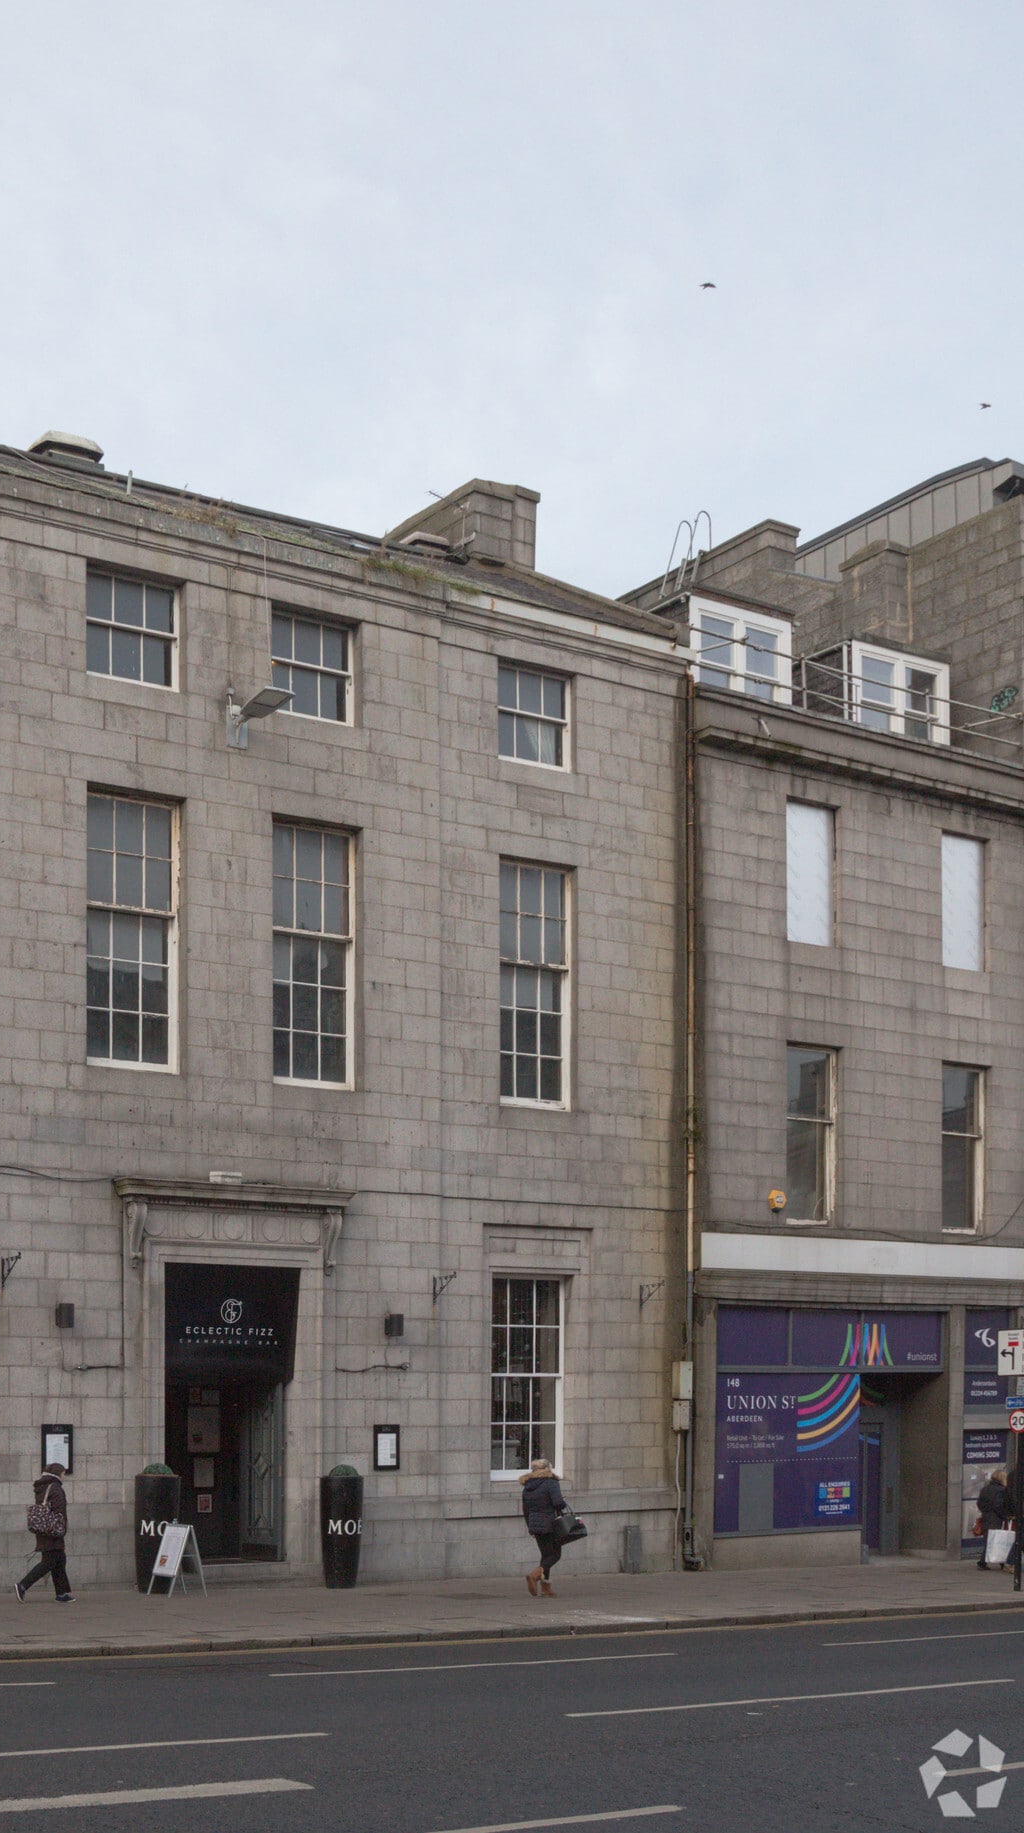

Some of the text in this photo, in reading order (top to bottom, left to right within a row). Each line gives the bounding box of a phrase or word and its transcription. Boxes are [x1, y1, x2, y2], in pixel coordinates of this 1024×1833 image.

[185, 1326, 274, 1336] ECLECTIC FIZZ
[179, 1338, 248, 1346] CHAMPAGNE
[907, 1352, 937, 1361] #unionst
[727, 1378, 740, 1387] 148
[727, 1395, 777, 1410] UNION
[726, 1415, 763, 1423] ABERDEEN
[1012, 1416, 1024, 1426] 20
